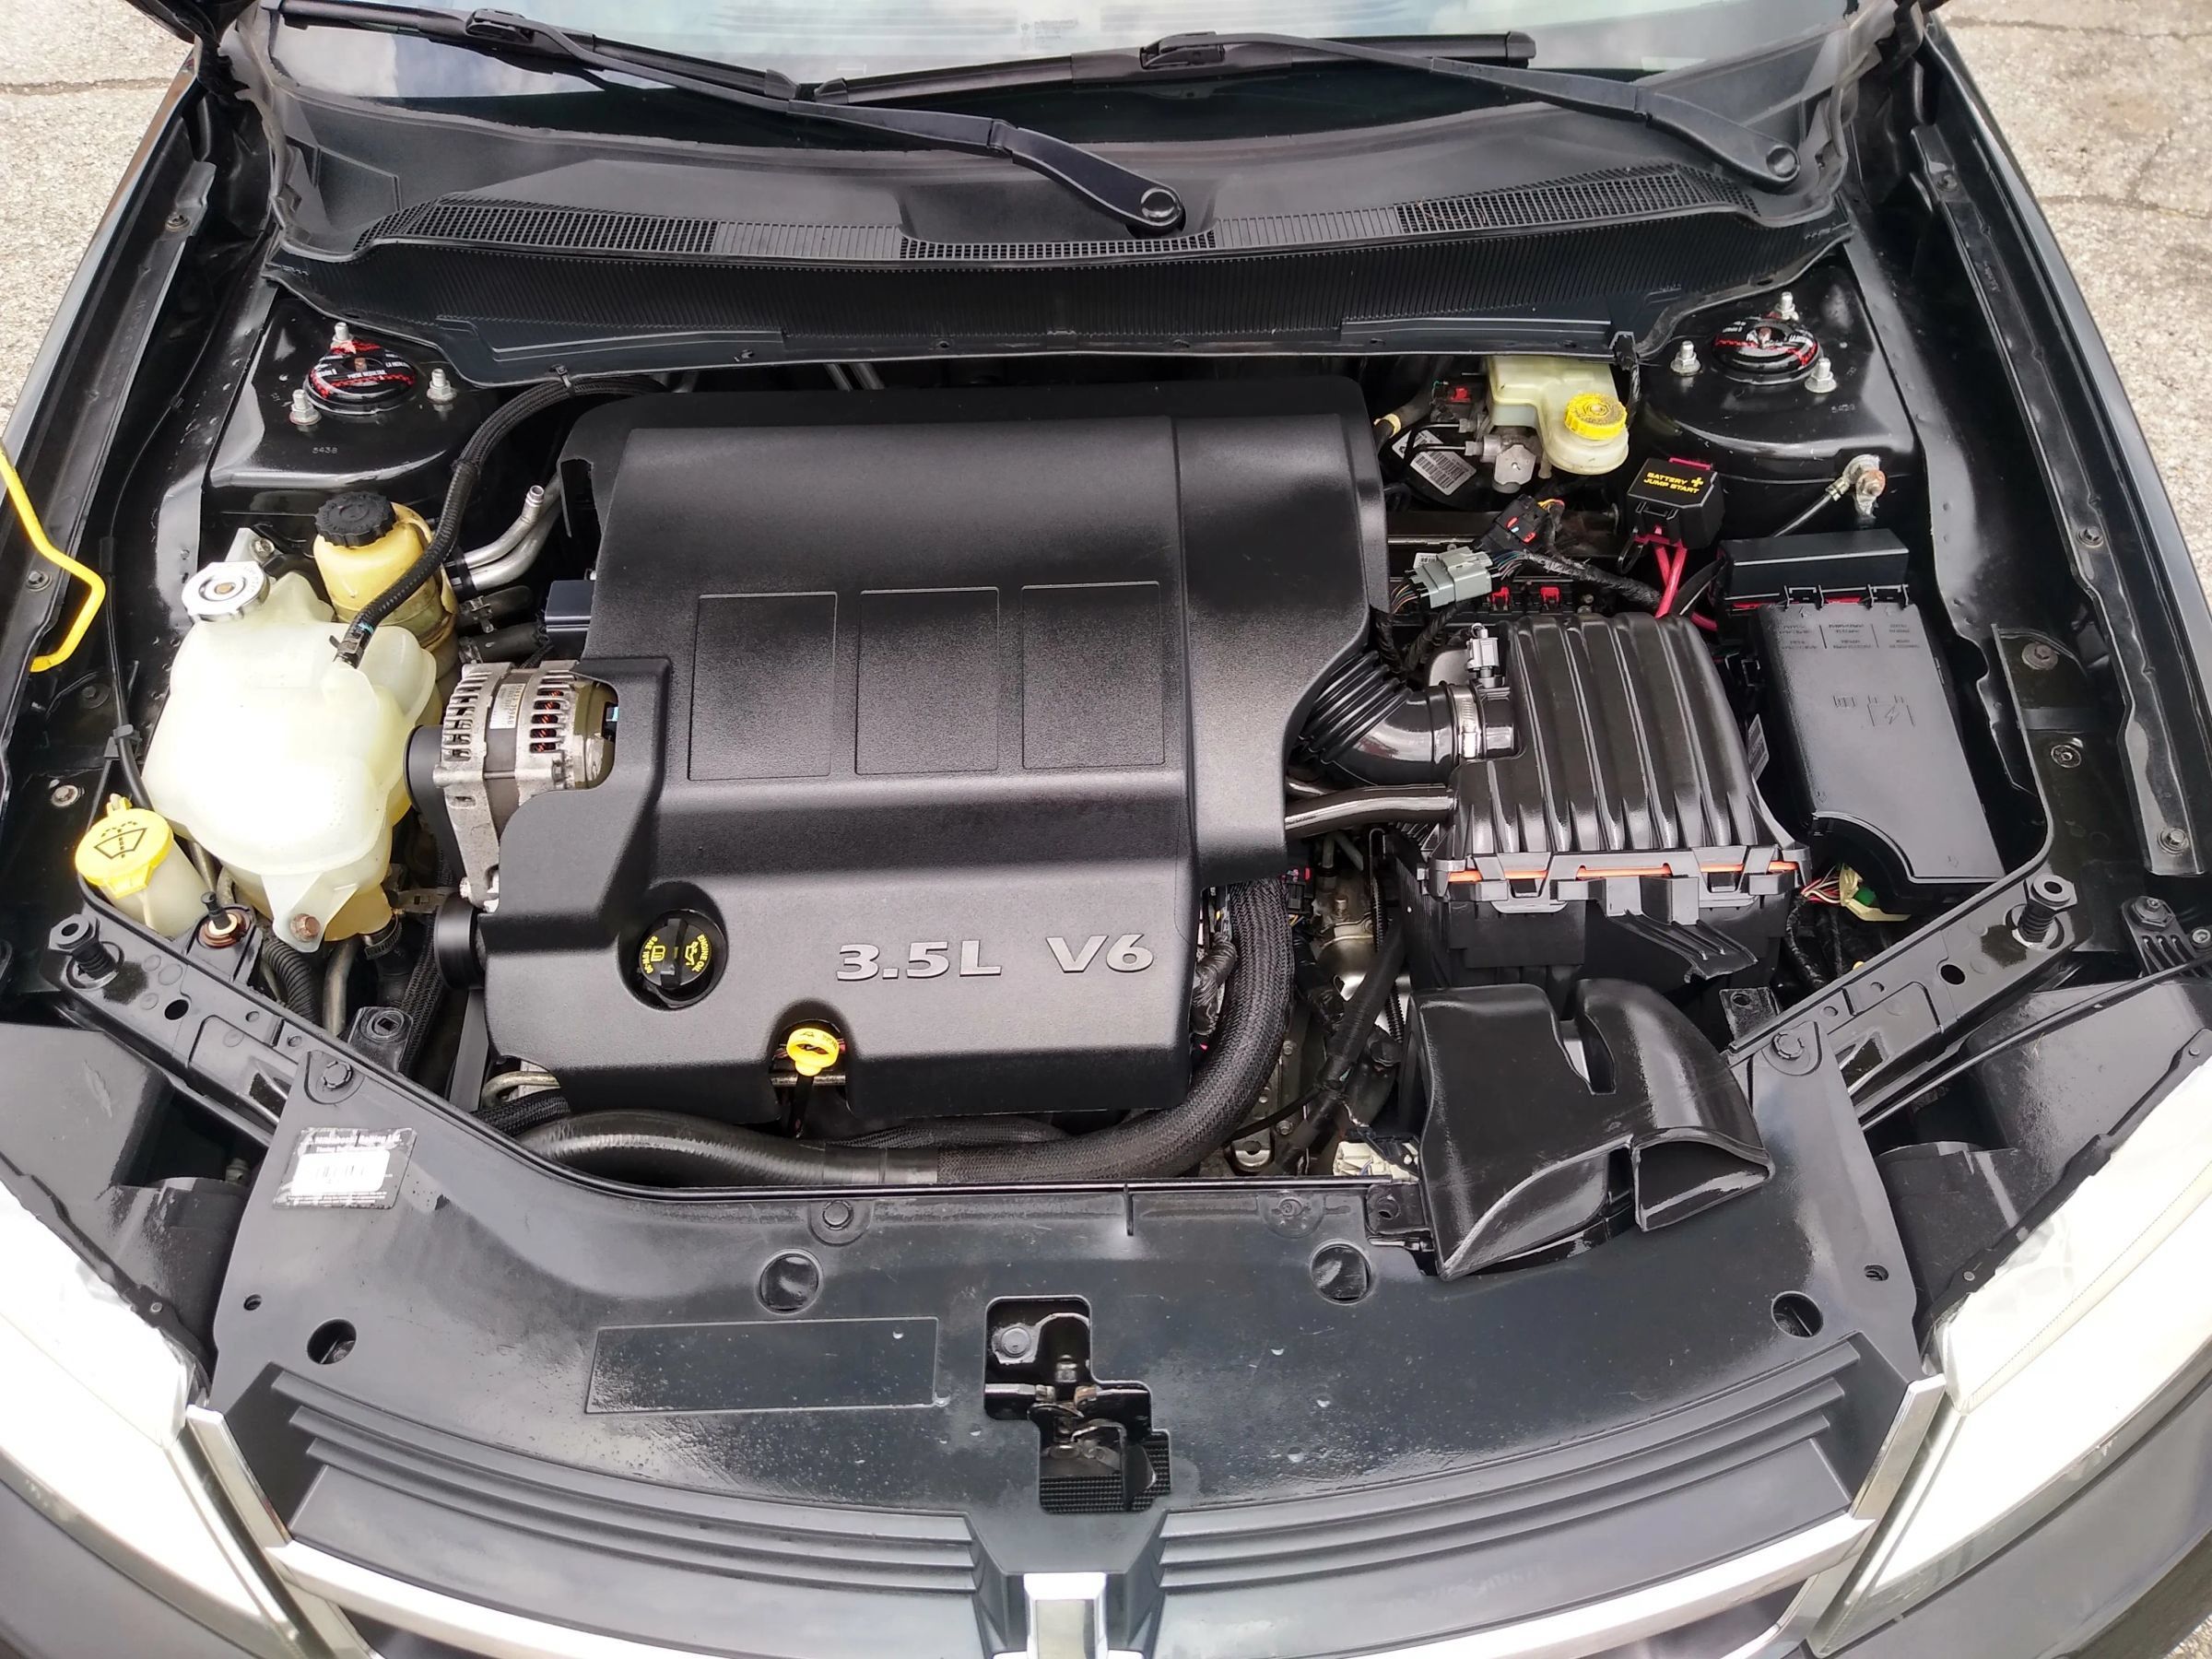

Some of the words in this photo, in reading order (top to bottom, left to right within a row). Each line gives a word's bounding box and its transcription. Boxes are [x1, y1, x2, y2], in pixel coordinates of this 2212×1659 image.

[1643, 477, 1669, 488] JUMP
[1669, 483, 1700, 494] START
[1646, 472, 1688, 485] BATTERY
[644, 935, 658, 950] SAE
[697, 934, 709, 961] ENGINE
[835, 939, 1002, 981] 3.5L
[1045, 933, 1154, 973] V6
[691, 960, 705, 972] OIL
